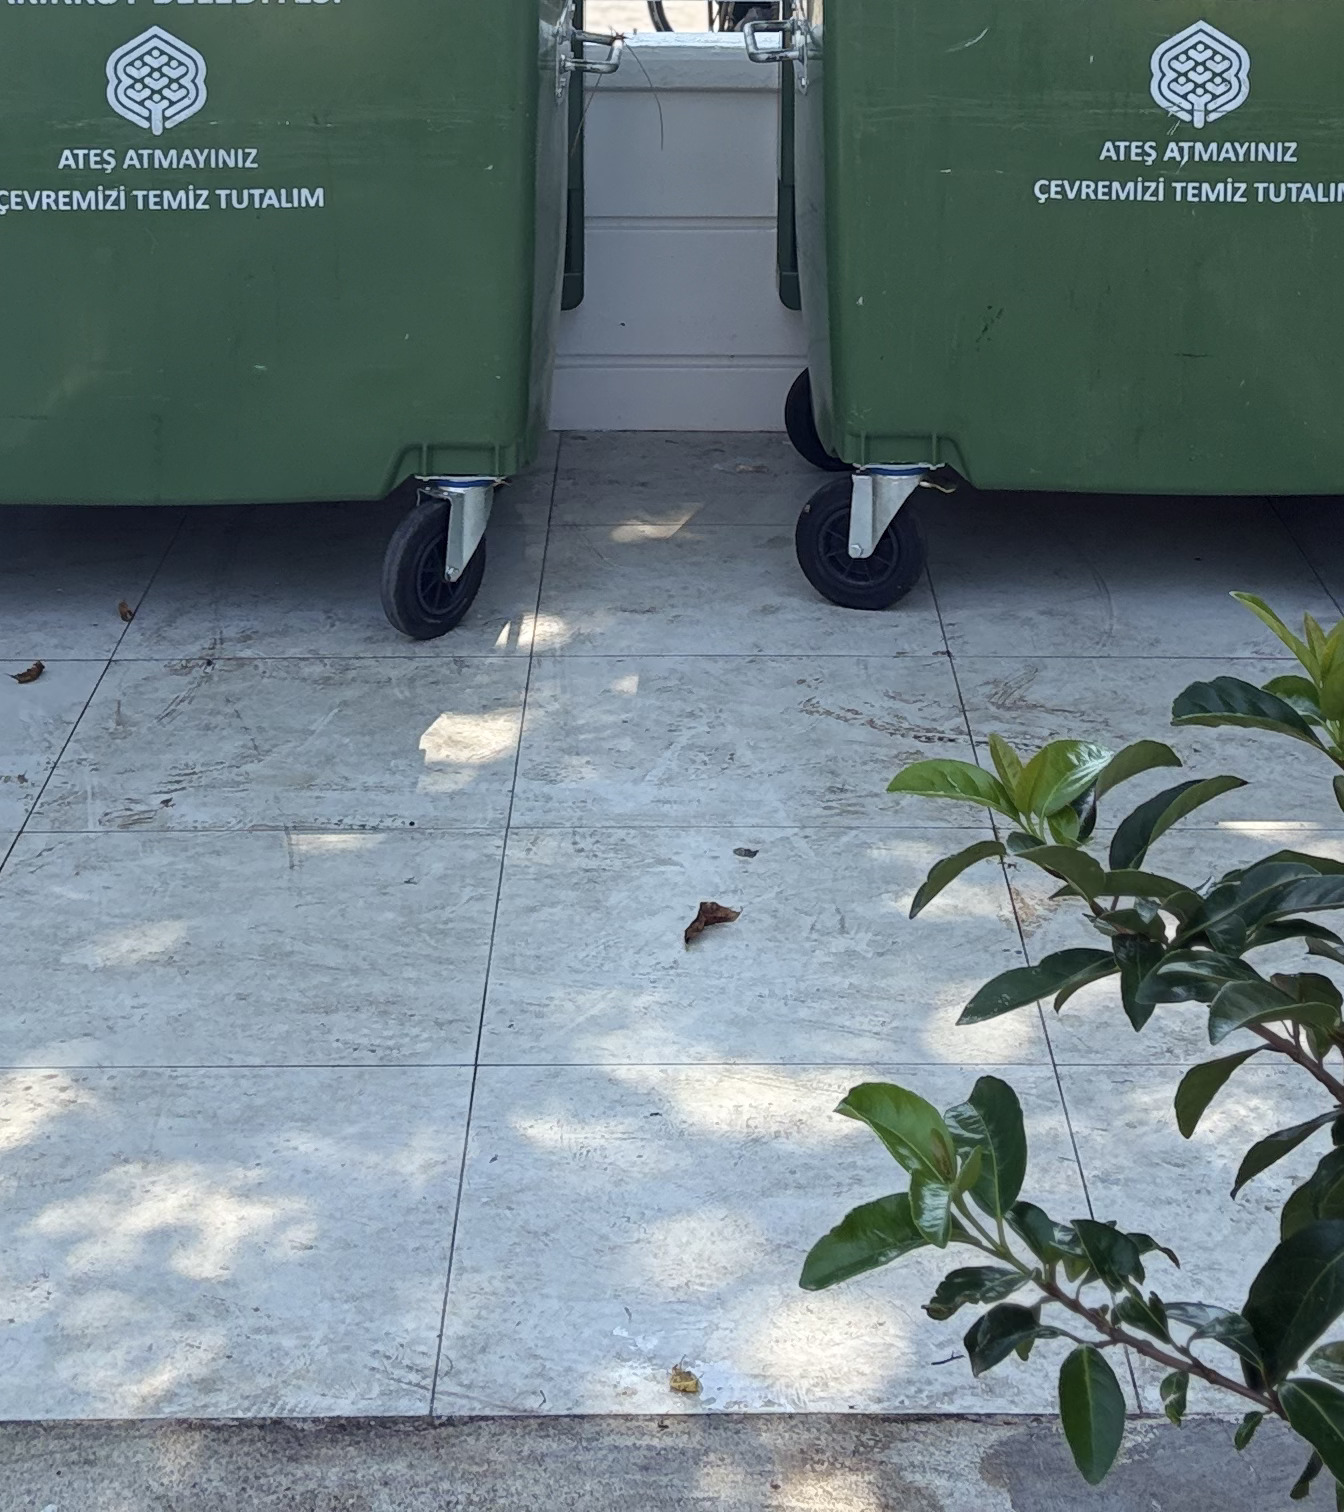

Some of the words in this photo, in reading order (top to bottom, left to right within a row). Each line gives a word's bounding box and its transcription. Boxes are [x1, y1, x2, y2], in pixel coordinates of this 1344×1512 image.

[57, 148, 117, 174] ATEŞ
[122, 148, 259, 169] ATMAYINIZ
[1099, 141, 1157, 166] ATEŞ
[1162, 141, 1298, 163] ATMAYINIZ
[131, 184, 210, 210] TEMİZ
[214, 187, 325, 209] TUTALIM
[1033, 176, 1165, 204] ÇEVREMİZİ
[1171, 177, 1248, 203] TEMİZ
